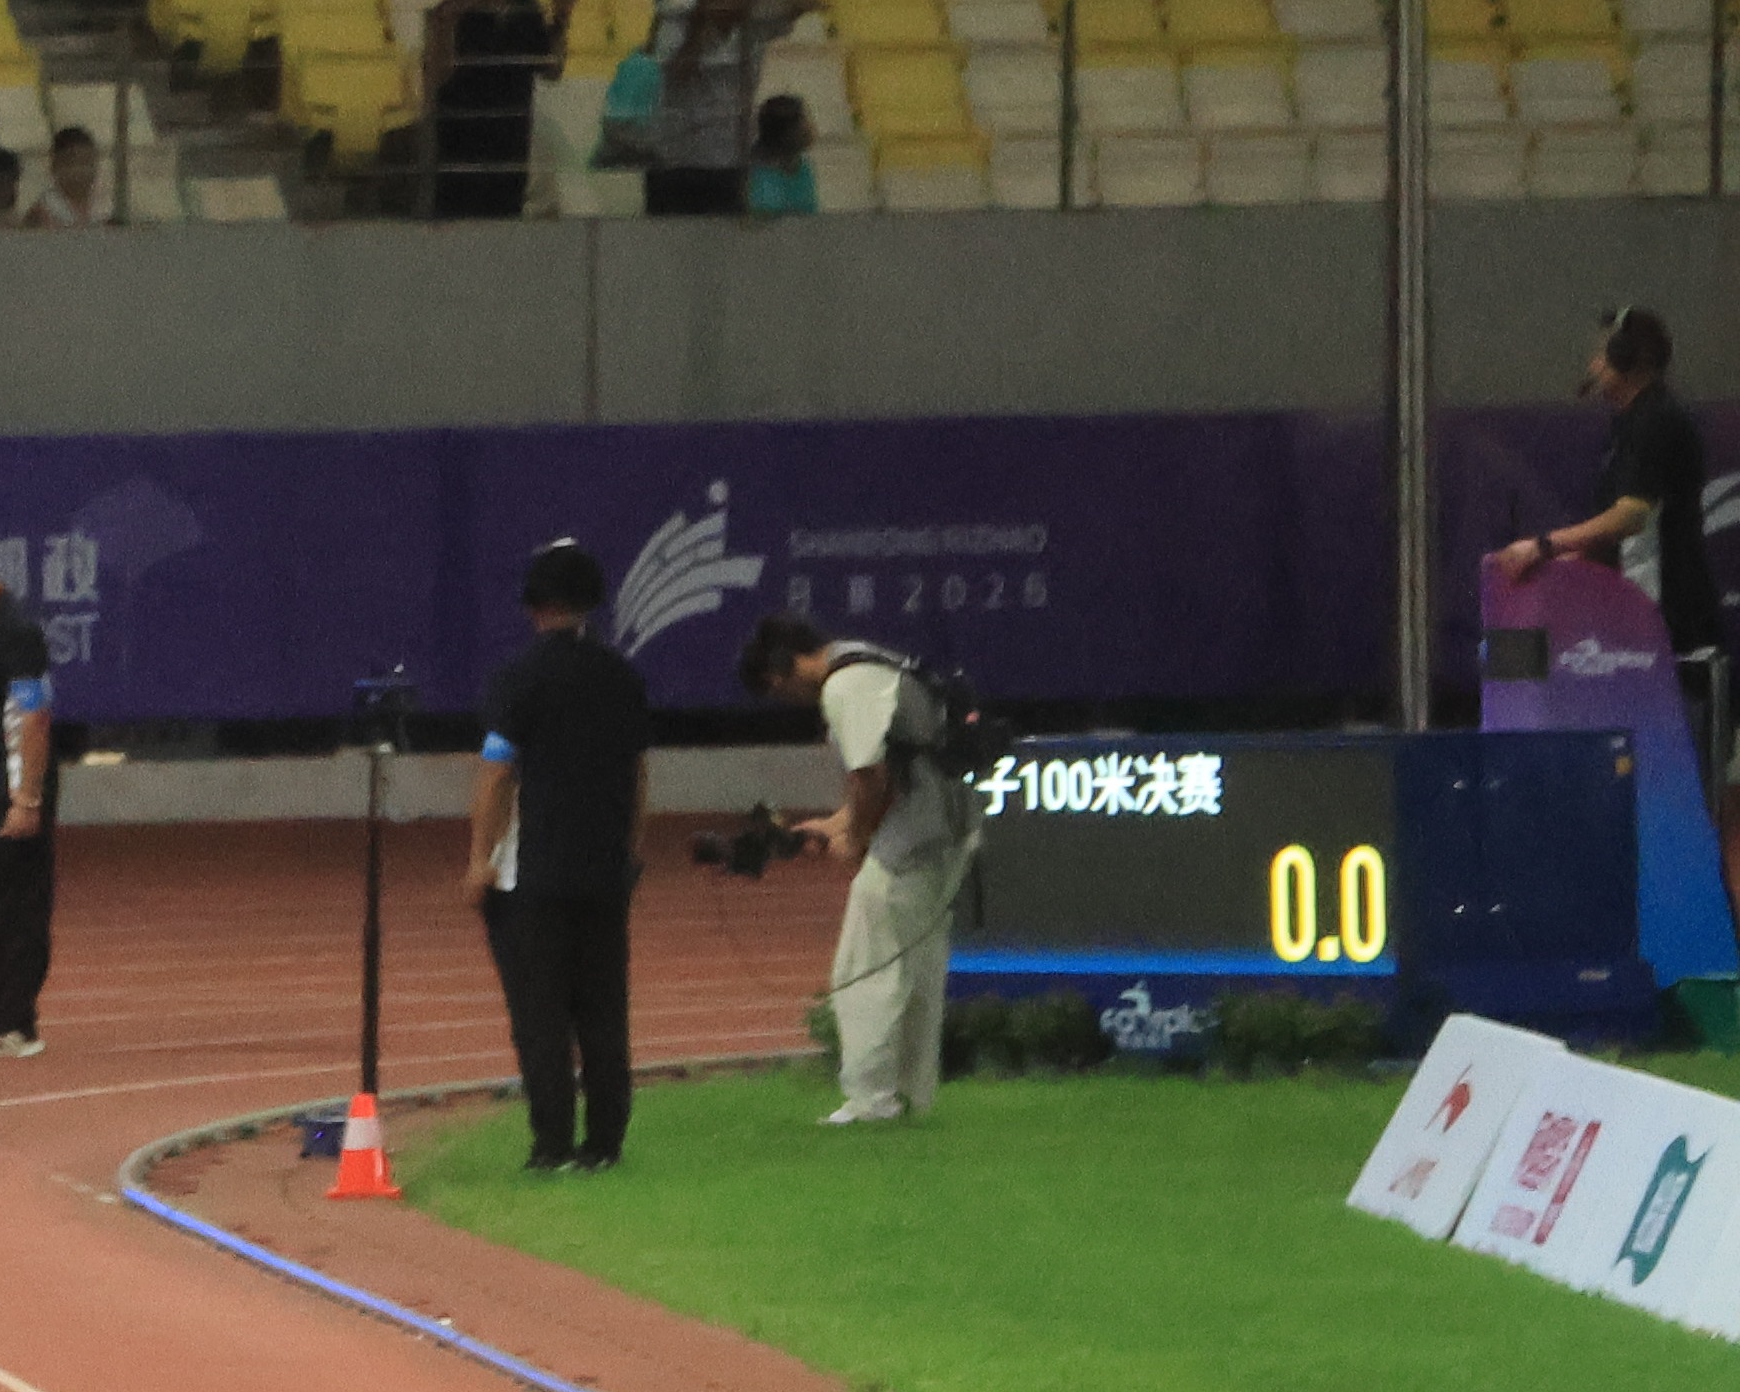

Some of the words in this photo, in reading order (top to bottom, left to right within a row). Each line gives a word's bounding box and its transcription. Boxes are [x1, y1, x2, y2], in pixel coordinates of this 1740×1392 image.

[964, 751, 1224, 817] 子100米决赛
[1269, 843, 1388, 964] 0.0
